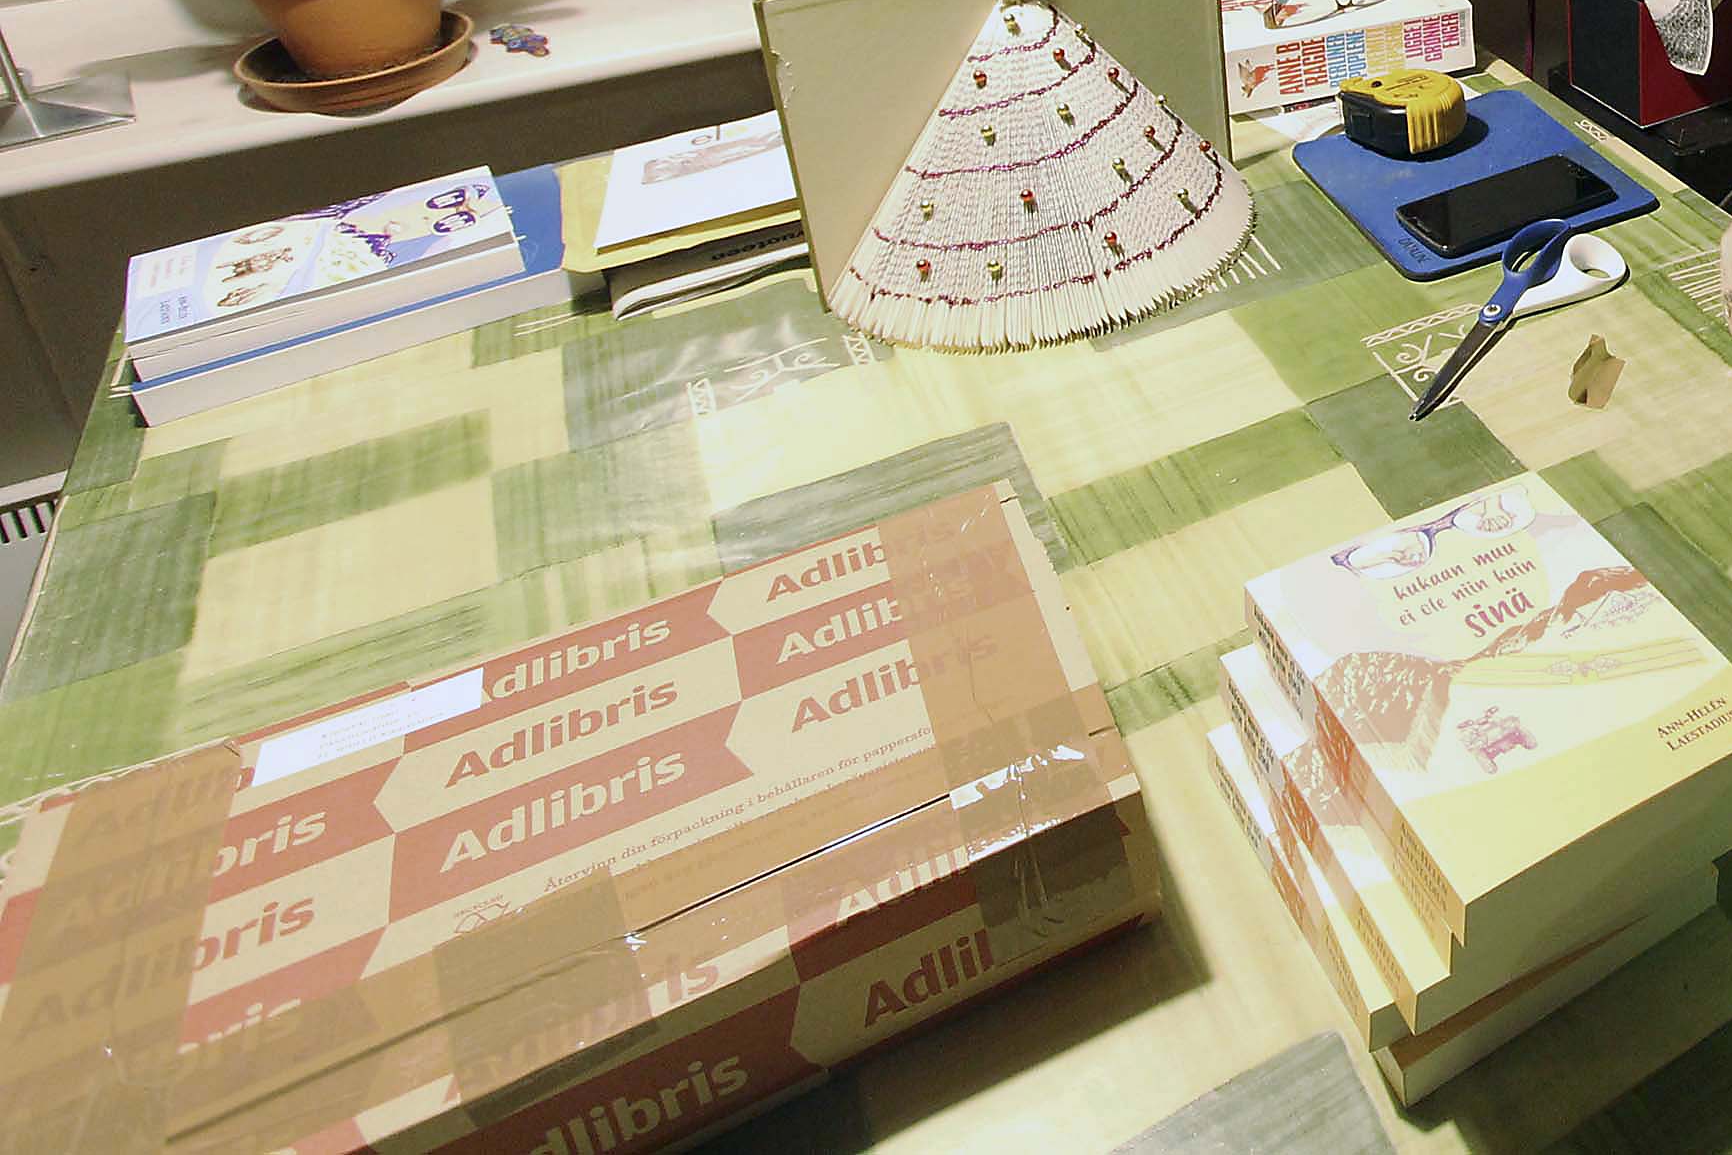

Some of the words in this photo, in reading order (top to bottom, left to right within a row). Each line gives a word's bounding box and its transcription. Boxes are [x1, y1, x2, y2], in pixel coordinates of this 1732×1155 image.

[1276, 41, 1301, 55] B
[1301, 36, 1329, 87] RAGDE
[1441, 12, 1460, 49] ENGER
[1276, 55, 1304, 95] ANNE
[1393, 564, 1465, 600] kukaan
[1472, 543, 1517, 566] muu
[1399, 609, 1417, 627] ei
[1420, 597, 1448, 616] ole
[1451, 578, 1489, 601] niin
[1492, 559, 1537, 584] kuin
[1464, 587, 1535, 638] sinä
[483, 620, 672, 707] dlibris
[445, 680, 678, 789] Adlibris
[440, 752, 685, 874] Adlibris
[621, 837, 648, 859] din
[651, 801, 745, 848] förpackning
[757, 766, 835, 803] behållaren
[838, 755, 859, 771] för
[863, 725, 932, 763] pappersfö
[528, 1052, 751, 1155] dlibris
